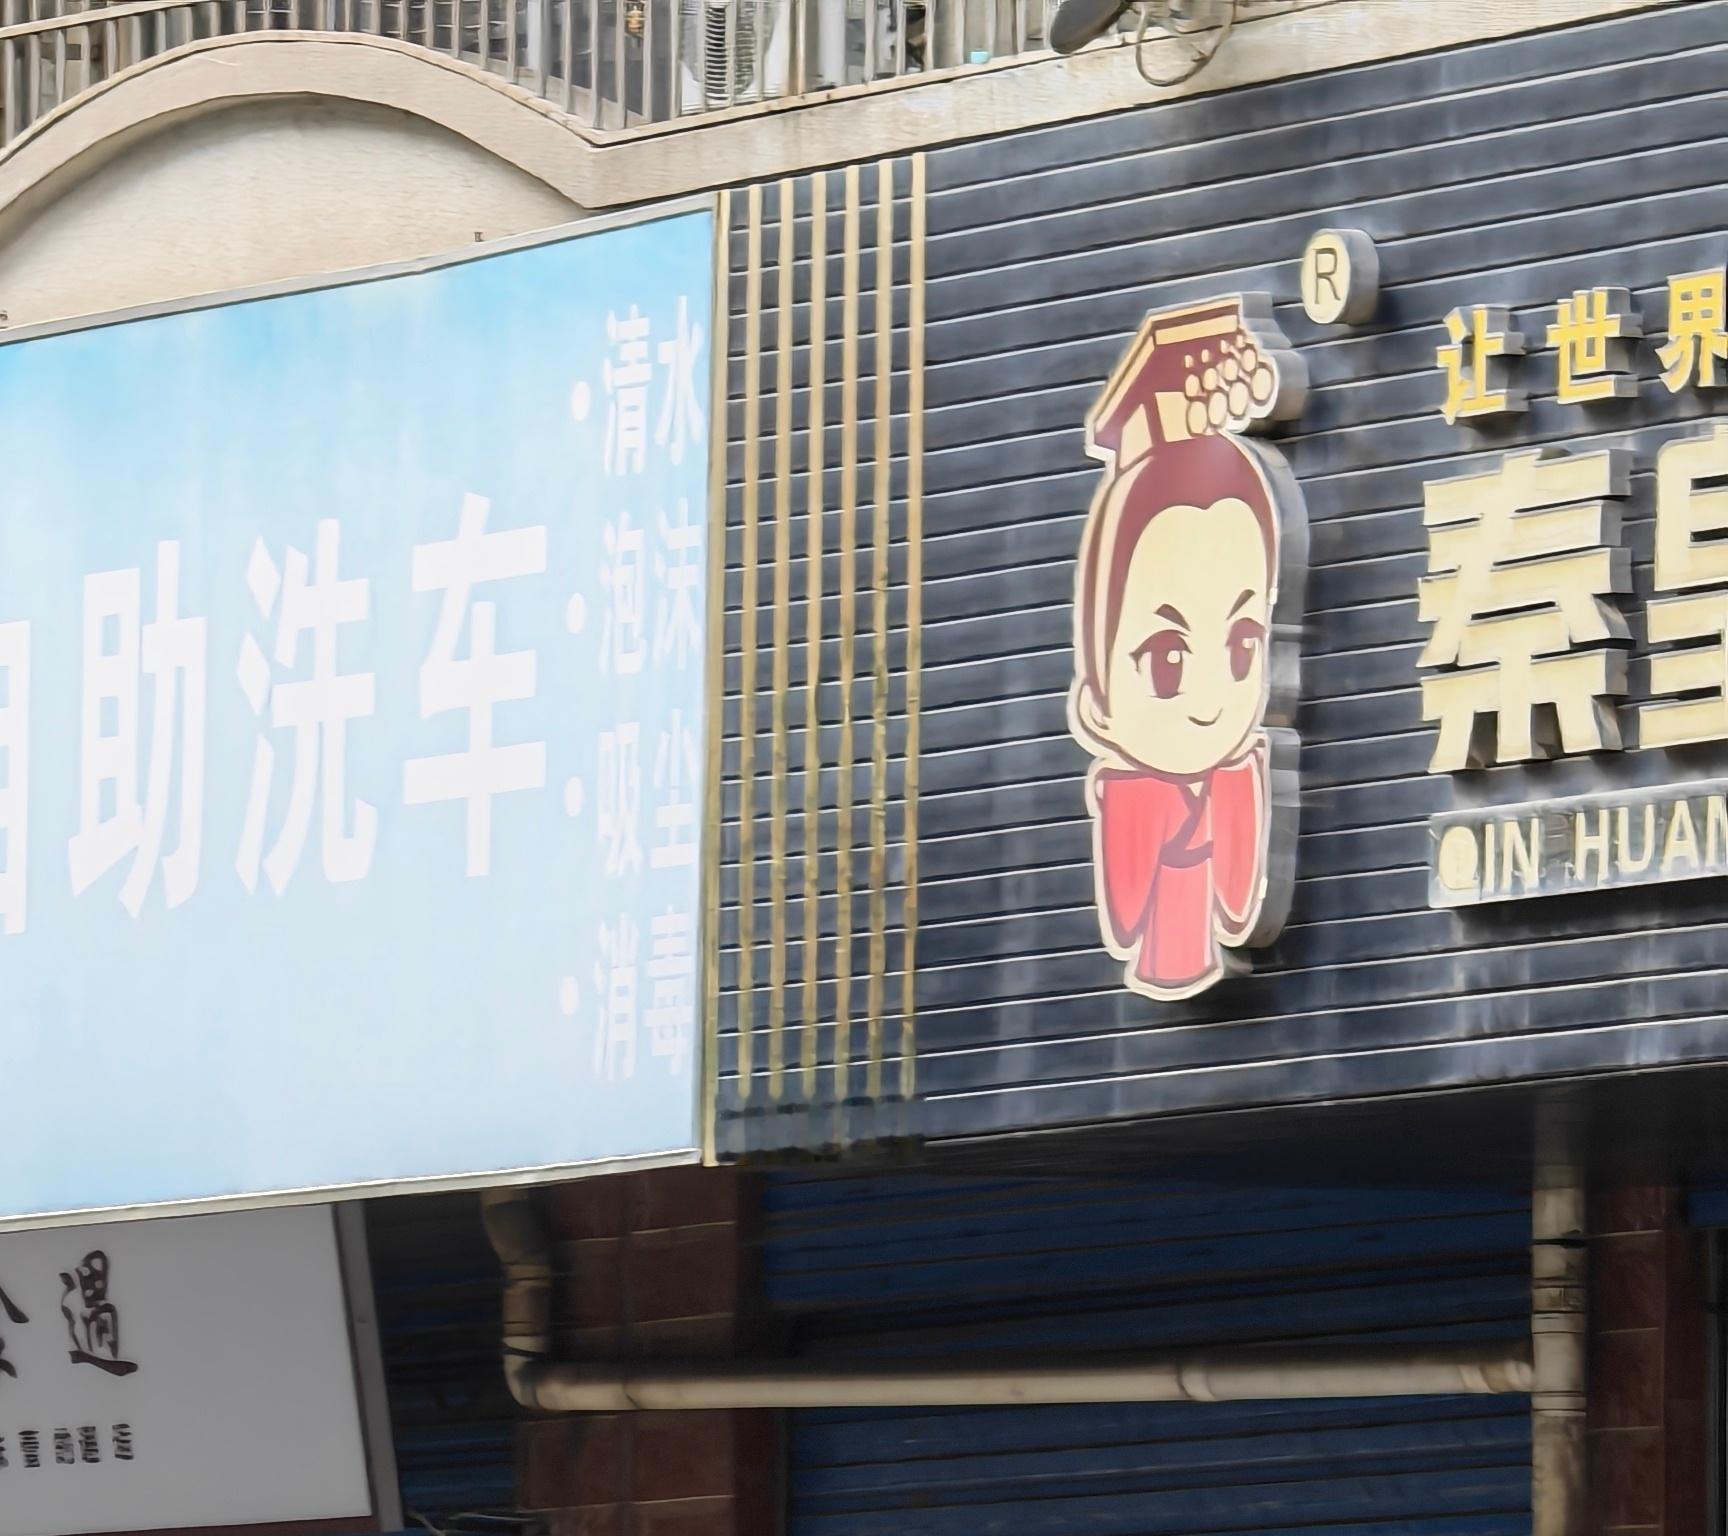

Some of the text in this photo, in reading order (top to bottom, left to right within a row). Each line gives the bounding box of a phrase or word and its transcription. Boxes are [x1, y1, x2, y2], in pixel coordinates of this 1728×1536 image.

[603, 295, 706, 476] 清水
[1435, 266, 1728, 426] 让世界
[599, 498, 703, 677] 泡沫
[597, 709, 701, 878] 吸尘
[593, 905, 696, 1082] 消毒
